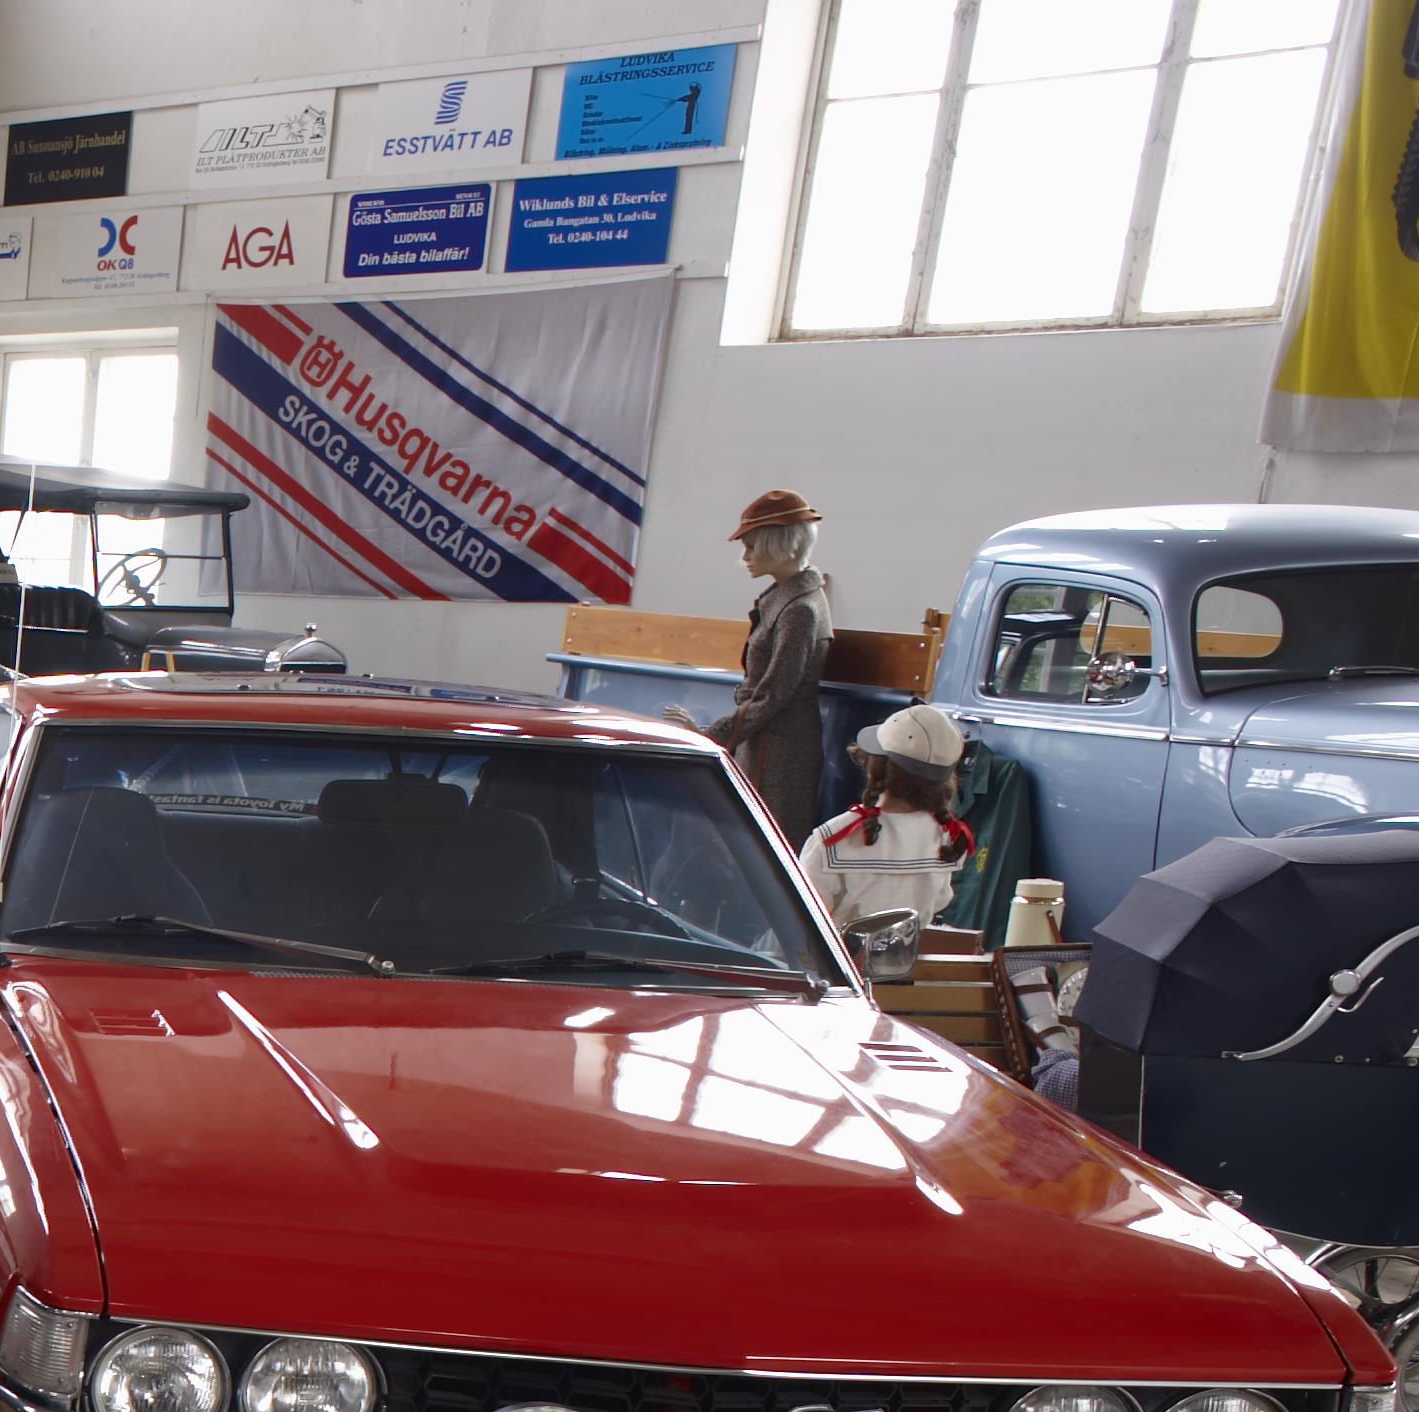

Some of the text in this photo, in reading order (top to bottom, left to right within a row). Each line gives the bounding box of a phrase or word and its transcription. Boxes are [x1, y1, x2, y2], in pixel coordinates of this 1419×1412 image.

[620, 52, 675, 68] LUDVIKA
[74, 130, 126, 154] Järnhandel
[382, 128, 513, 157] ESSTVÄTT AB
[27, 172, 46, 184] Tel.
[519, 190, 668, 212] Wiklunds Bil & Elservice
[353, 201, 484, 226] Gösta Samuelsson Bil AB
[523, 217, 554, 229] Gamla
[617, 210, 657, 222] Ludvika
[222, 221, 295, 271] AGA
[394, 231, 437, 244] LUDVIKA
[547, 233, 565, 245] Tel.
[358, 246, 470, 266] Din bästa bilaffär!
[327, 358, 537, 543] Husqvarna
[278, 395, 501, 578] SKOG & TRÄDGÅRD
